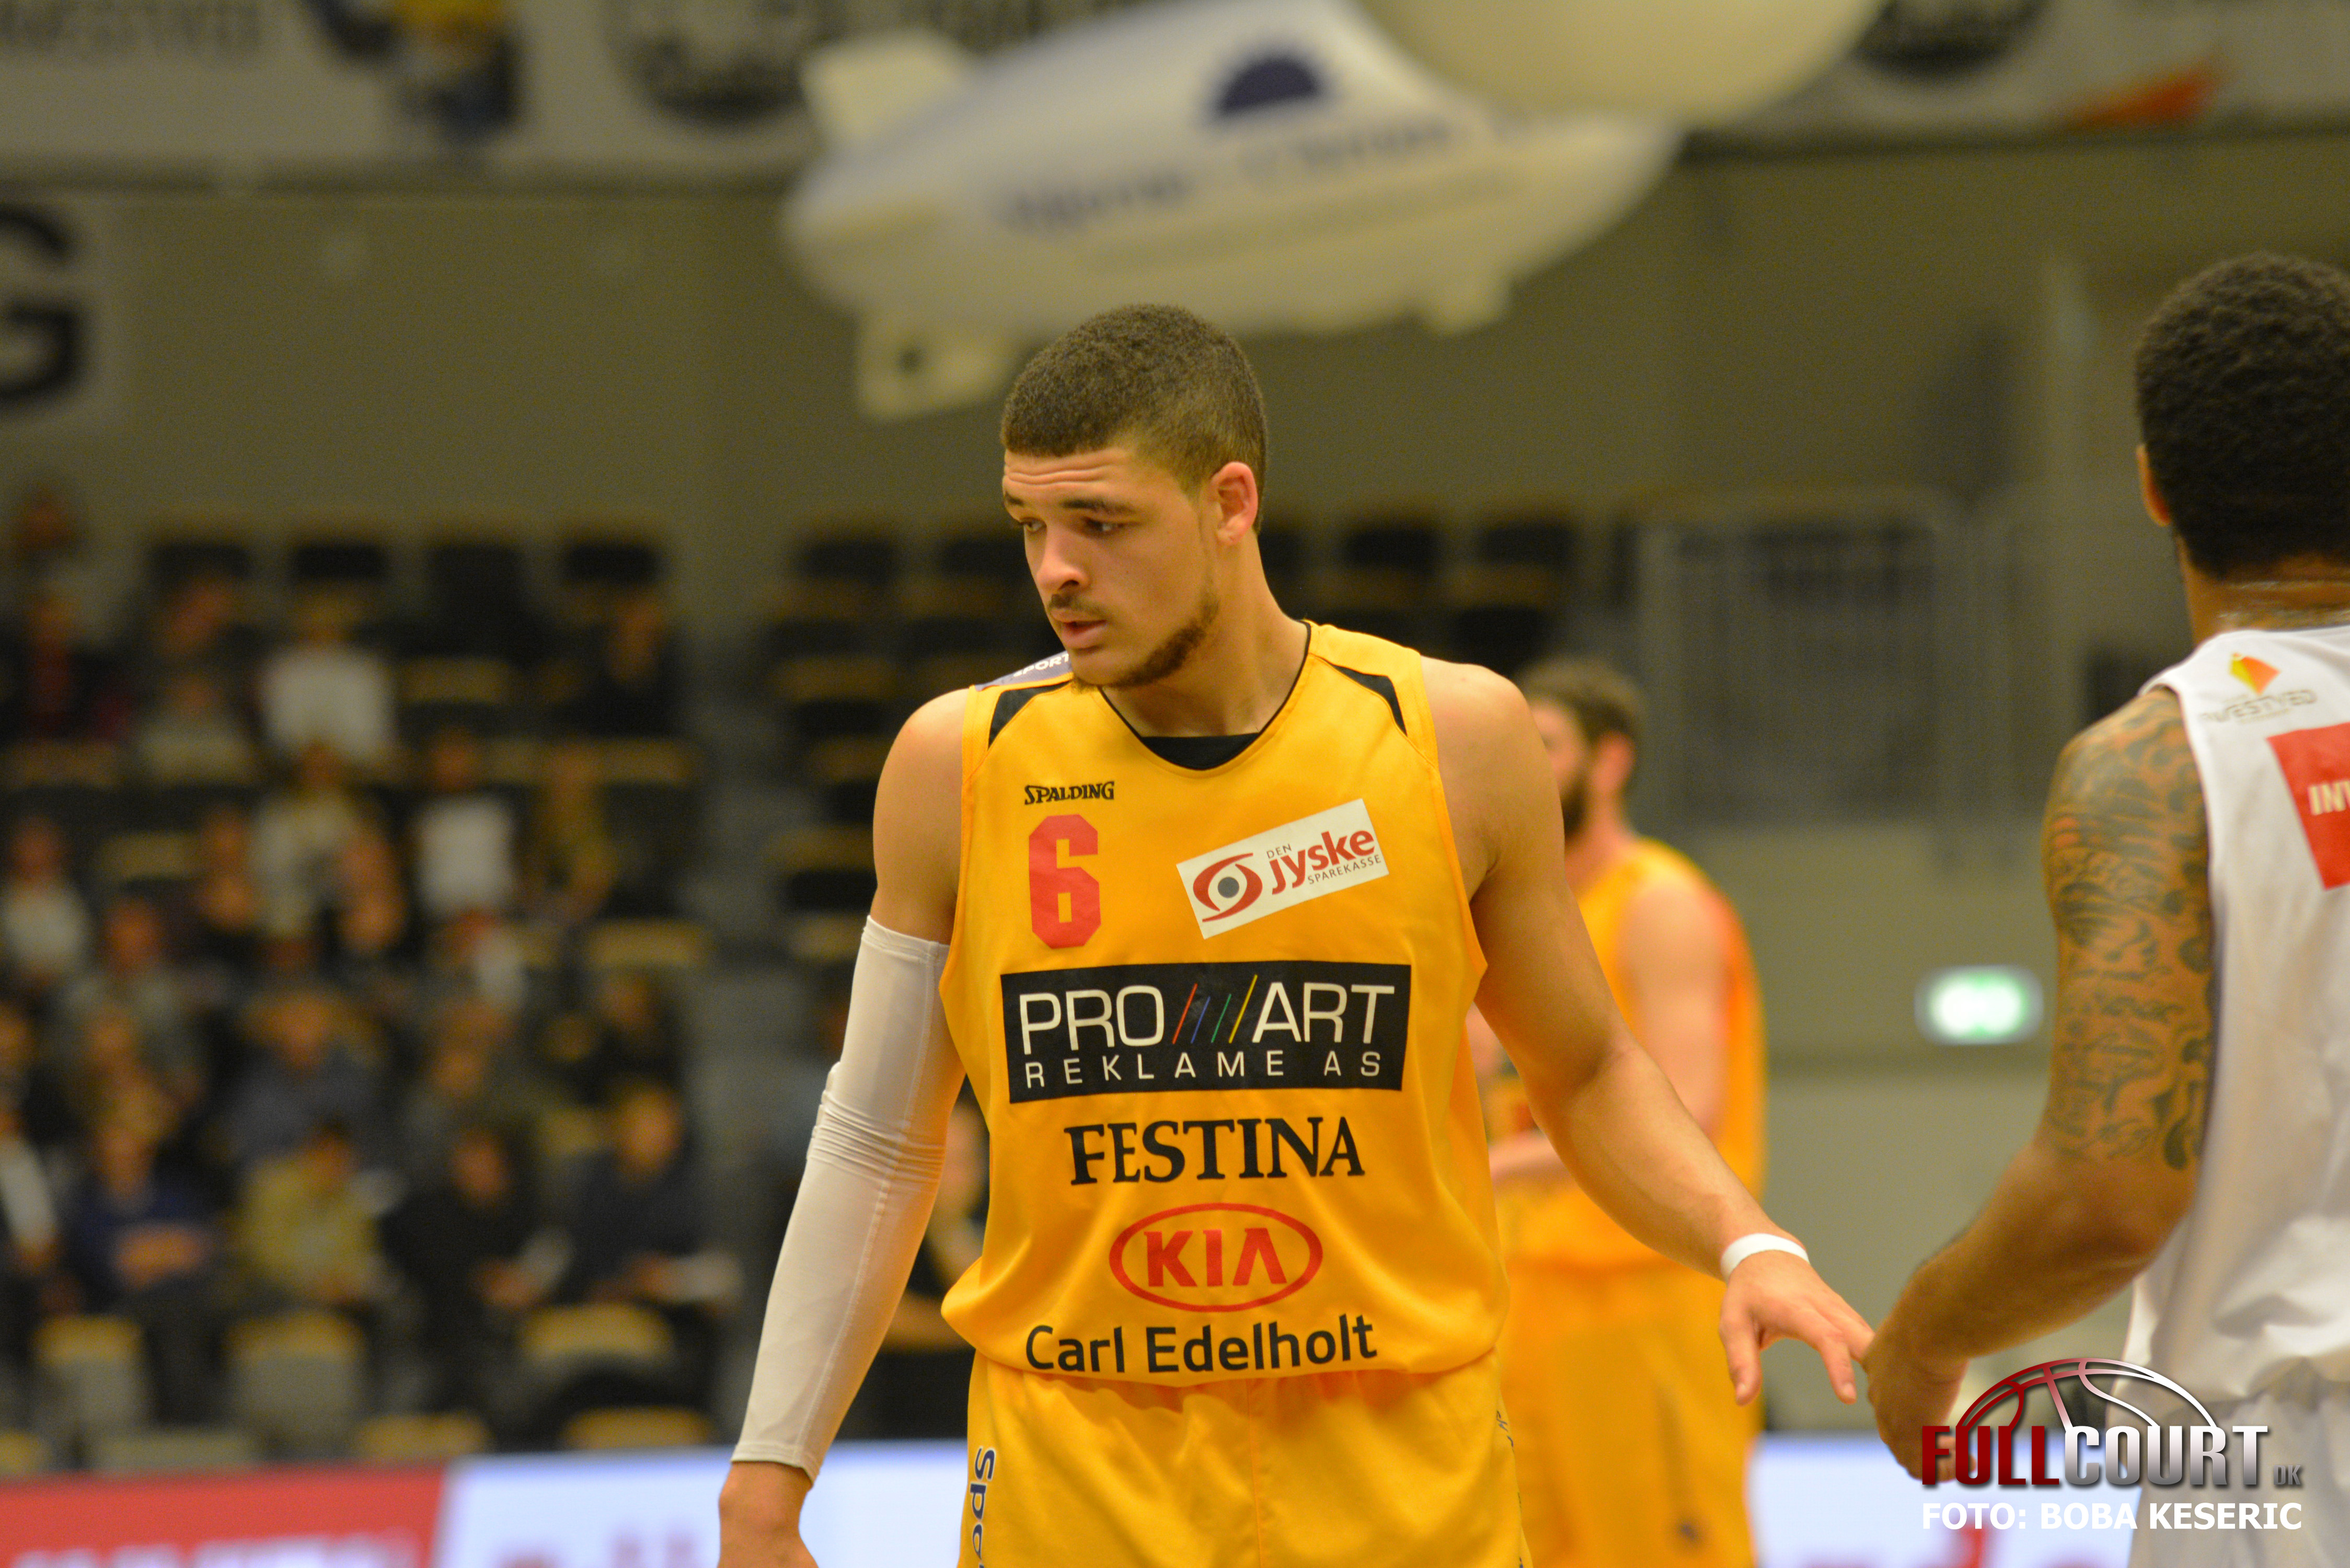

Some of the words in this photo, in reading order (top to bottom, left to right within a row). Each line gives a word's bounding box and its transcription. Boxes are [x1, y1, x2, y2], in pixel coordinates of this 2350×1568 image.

[1024, 781, 1115, 805] SPALDING
[1028, 813, 1101, 949] 6
[1266, 843, 1292, 859] DEN
[1269, 830, 1375, 895] jyske
[1307, 854, 1381, 885] SPAREKASSE
[1025, 1050, 1284, 1089] REKLAME
[1323, 1051, 1381, 1077] AS
[1064, 1116, 1365, 1186] FESTINA
[1143, 1227, 1287, 1288] KIA
[1026, 1324, 1125, 1374] Carl
[1146, 1313, 1378, 1374] Edelholt
[970, 1446, 996, 1568] Spo
